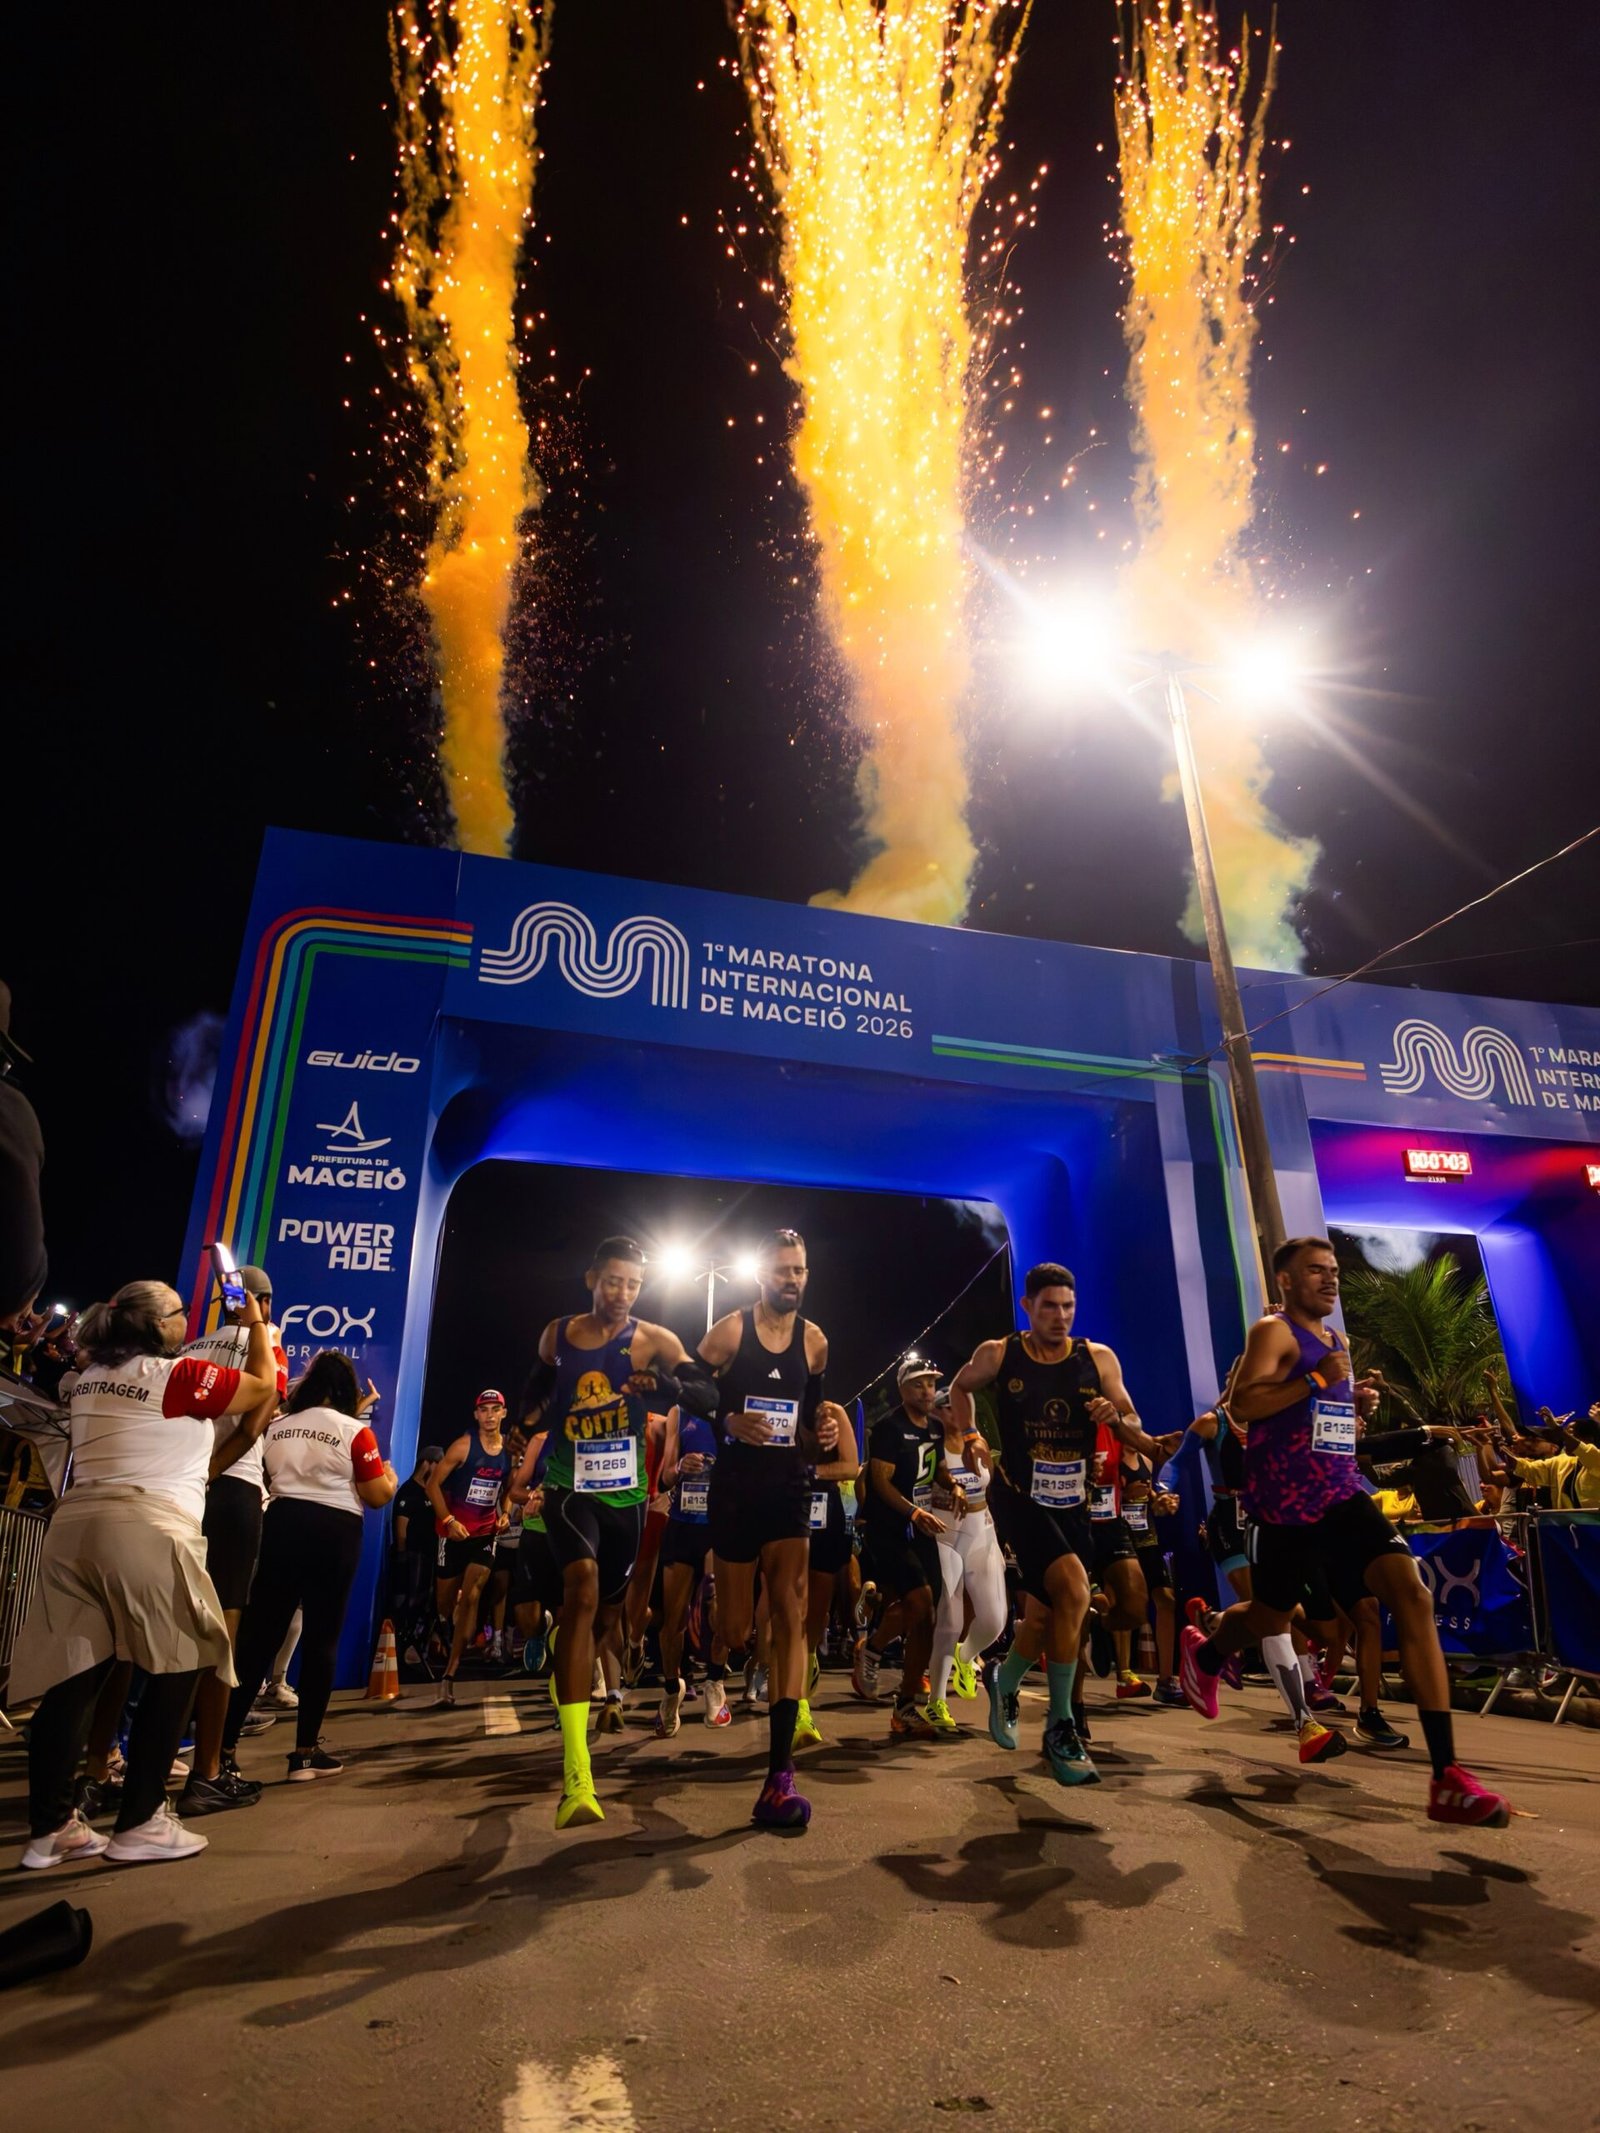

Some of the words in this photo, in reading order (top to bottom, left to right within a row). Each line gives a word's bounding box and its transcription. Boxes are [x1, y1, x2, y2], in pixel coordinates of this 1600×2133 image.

[728, 945, 873, 983] MARATONA
[701, 967, 912, 1013] INTERNACIONAL
[701, 993, 734, 1016] DE
[743, 999, 847, 1030] MACEIÓ
[856, 1014, 913, 1039] 2026
[1542, 1091, 1570, 1109] DE
[311, 1154, 373, 1166] PREFEITURA
[375, 1158, 389, 1167] DE
[287, 1165, 406, 1191] MACEIÓ
[278, 1218, 395, 1247] POWER
[328, 1245, 393, 1272] ADE
[280, 1304, 376, 1338] FOX
[272, 1429, 341, 1447] ARBITRAGEM
[584, 1458, 627, 1471] 21269
